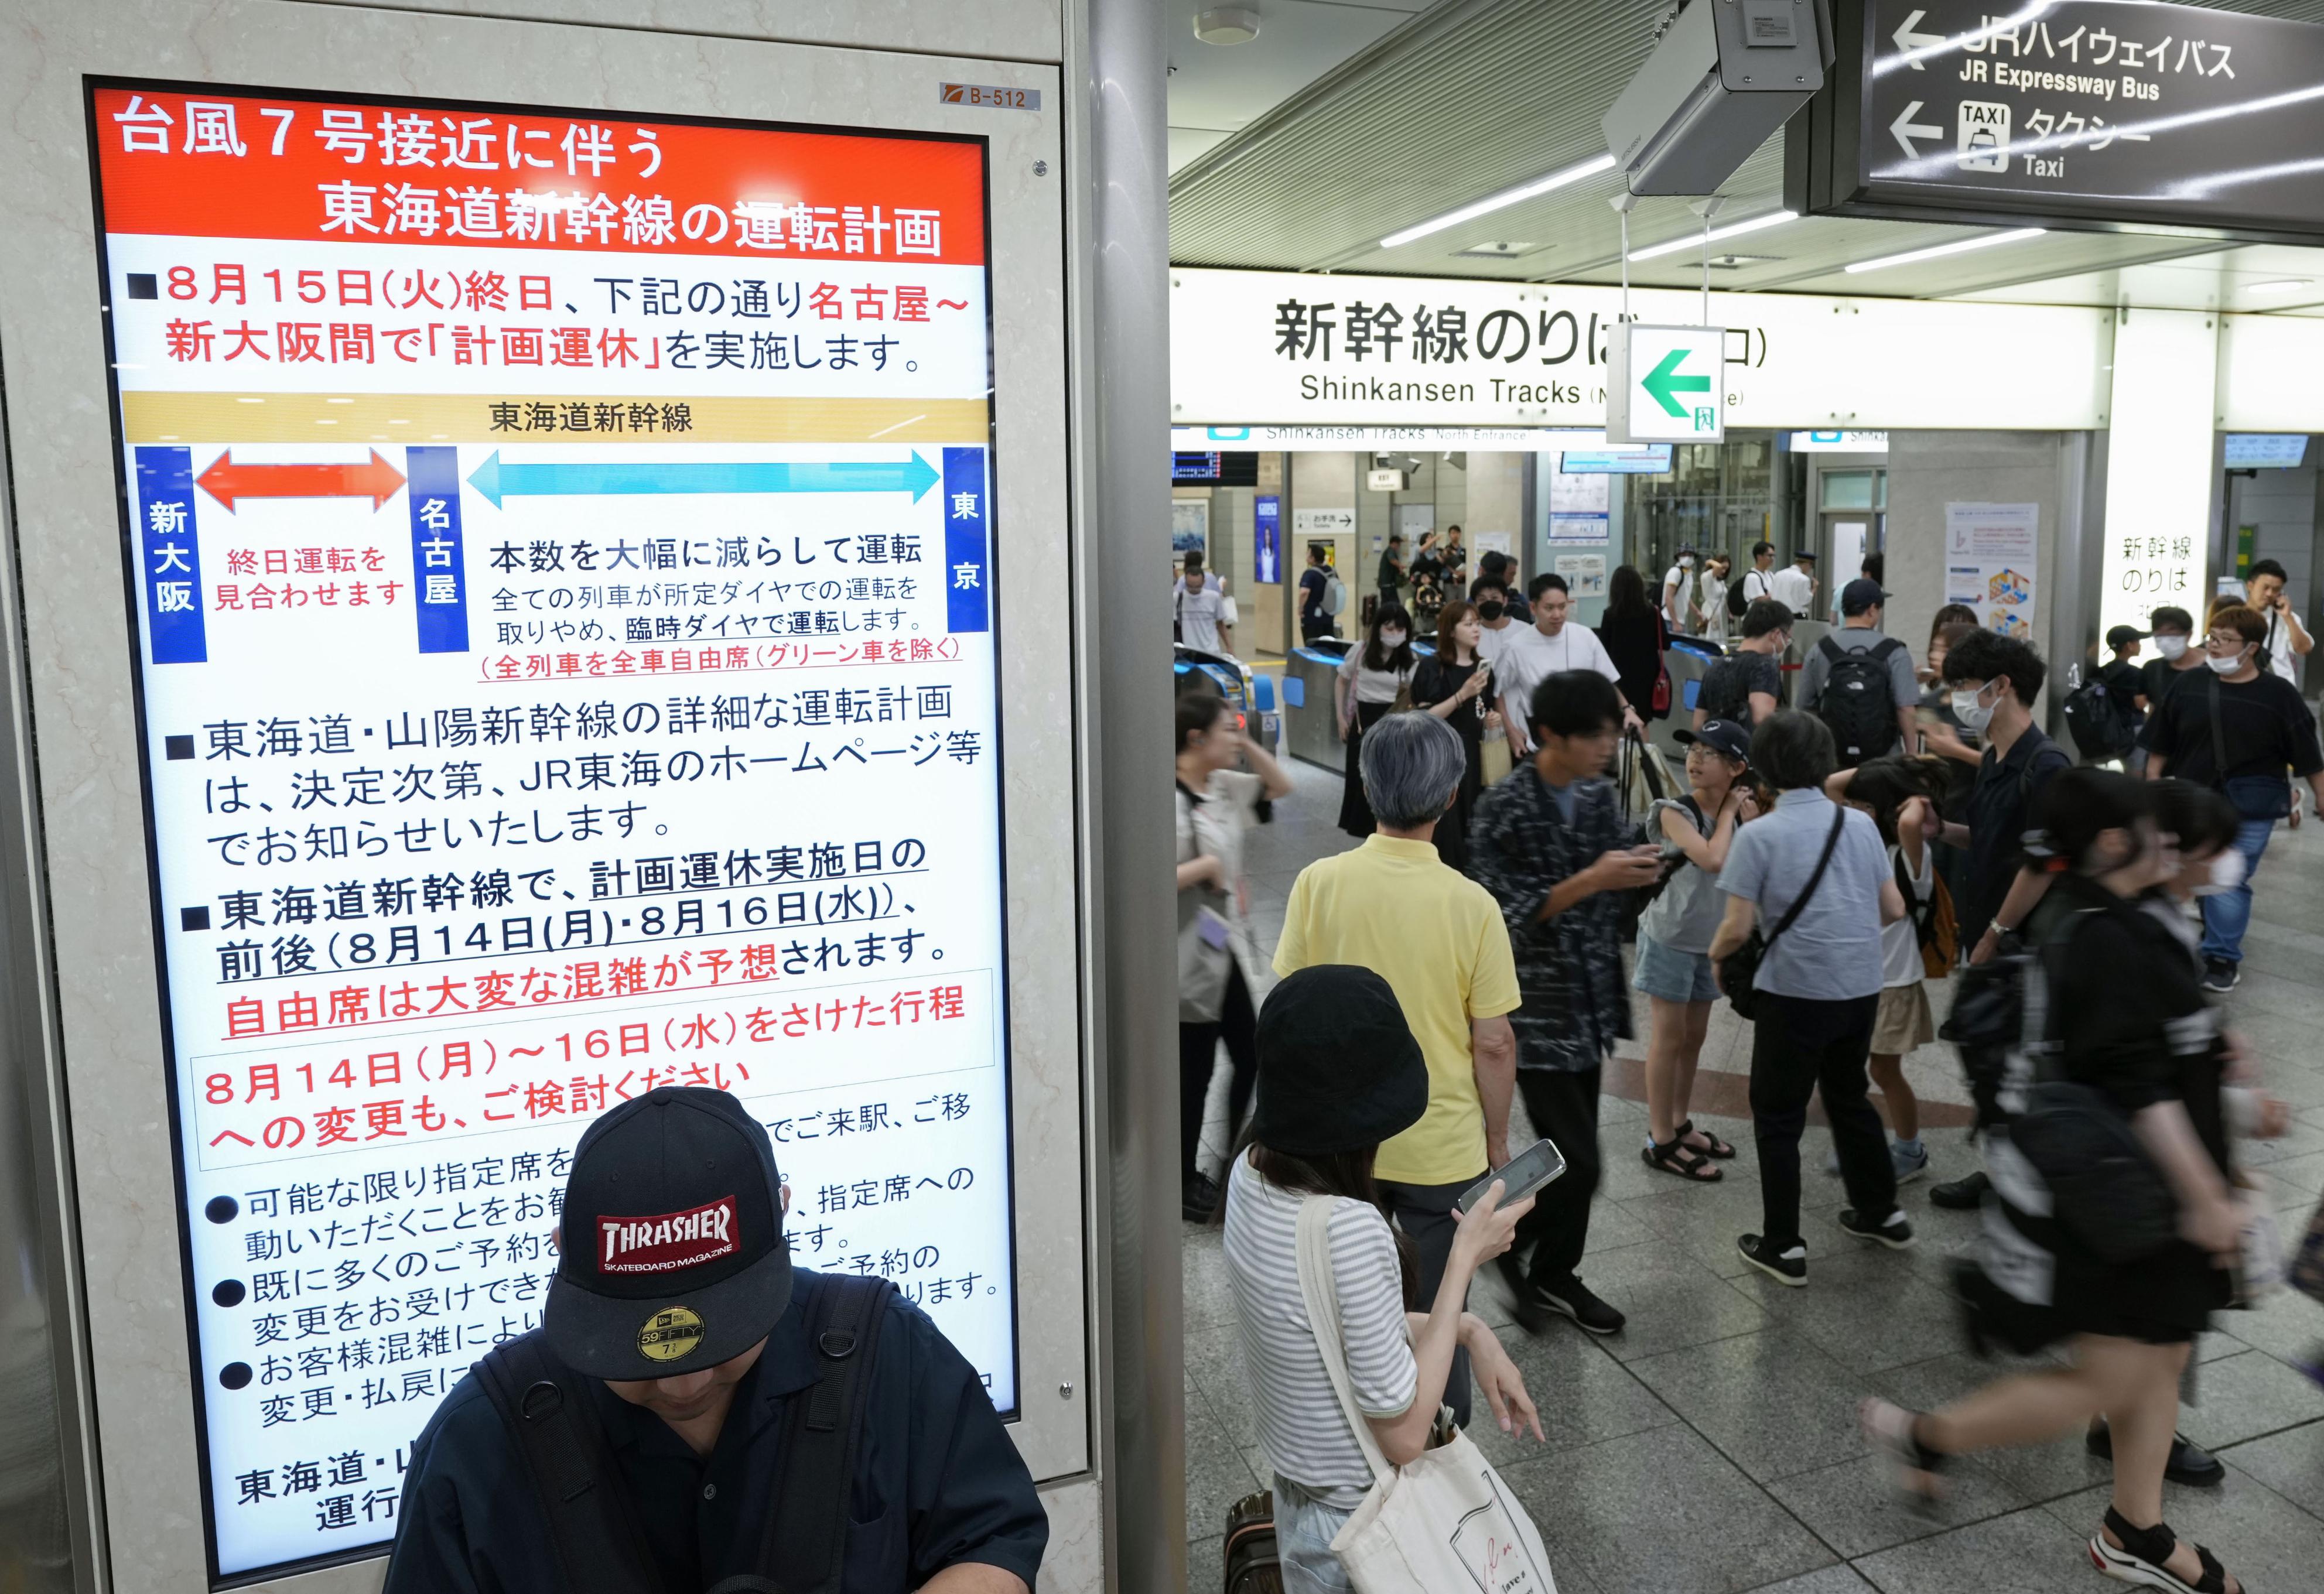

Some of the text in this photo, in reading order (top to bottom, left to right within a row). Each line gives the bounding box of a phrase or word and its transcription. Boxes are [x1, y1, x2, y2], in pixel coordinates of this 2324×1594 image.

[970, 87, 1026, 108] B-512
[1960, 59, 2159, 101] JR Expressway Bus
[1964, 105, 2005, 125] TAXI
[2025, 108, 2151, 152] タクシー
[113, 95, 662, 179] 台風7号接近に伴う
[2024, 153, 2064, 178] Taxi
[317, 179, 941, 258] 東海道新幹線の運転計画
[1301, 375, 1474, 402] Shinkansen
[1490, 379, 1580, 403] Tracks
[488, 401, 693, 433] 東海道新幹線
[149, 501, 195, 613] 新大阪
[227, 546, 387, 577] 終日運転を
[419, 498, 459, 606] 名古屋
[490, 533, 922, 574] 本数を大幅に減らして運転
[951, 492, 981, 590] 東京
[2123, 536, 2191, 562] 新幹線
[214, 580, 404, 611] 見合わせます
[491, 576, 918, 613] 全ての列車が所定ダイヤでの運転を
[497, 607, 920, 646] 取りやめ、臨時ダイヤで運転します。
[203, 685, 952, 761] 東海道・山陽新幹線の詳細な運転計画
[207, 800, 668, 866] でお知らせいたします。
[217, 837, 926, 931] 東海道新幹線で、計画運休実施日の
[226, 928, 944, 1037] 自由席は大変な混雑が予想されます。
[209, 1061, 750, 1149] への変更も、ご検討ください
[245, 1147, 575, 1219] 可能な限り指定席を
[602, 1203, 731, 1263] THRASHER
[604, 1243, 733, 1272] SKATEBOARD MAGAZINE
[260, 1309, 544, 1387] お客様混雑により
[641, 1325, 698, 1344] 59FIFTY
[662, 1344, 670, 1354] 7
[316, 1487, 399, 1531] 運行
